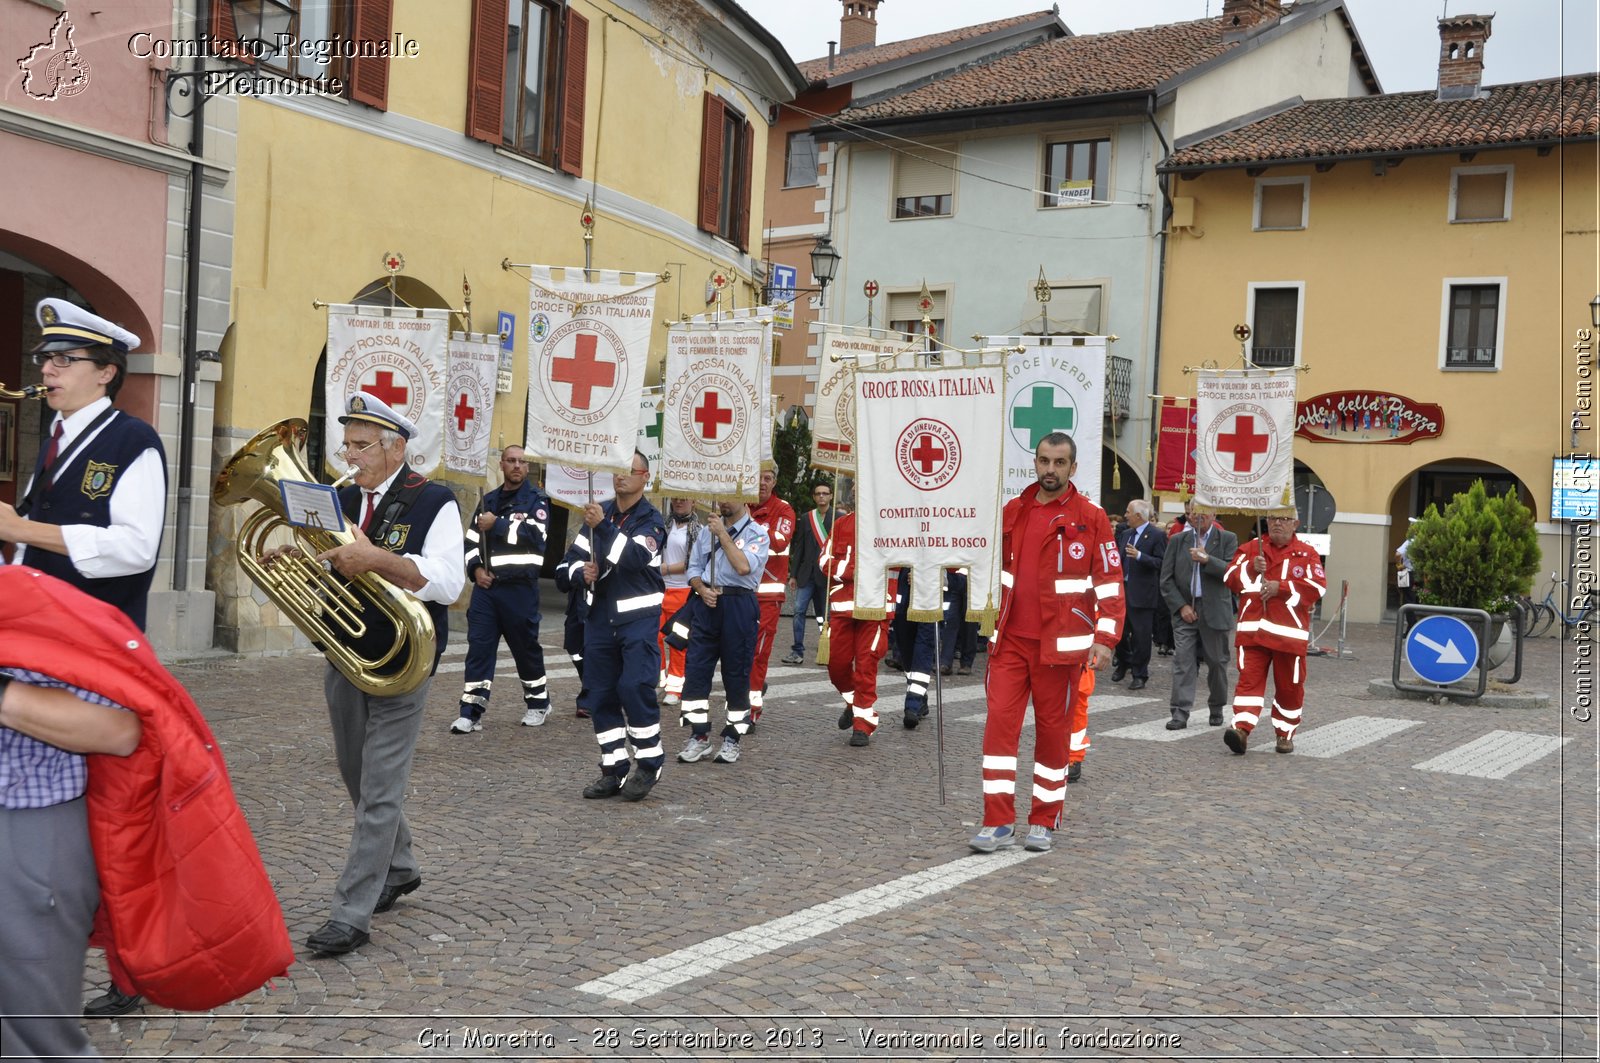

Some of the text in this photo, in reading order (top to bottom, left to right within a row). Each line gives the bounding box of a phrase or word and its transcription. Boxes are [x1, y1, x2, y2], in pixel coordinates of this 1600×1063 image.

[1060, 189, 1089, 197] VENDESI
[611, 296, 648, 307] SOCCORSO
[530, 301, 564, 313] CROCE
[606, 306, 651, 318] ITALIANA
[399, 322, 432, 332] SOCCORSO
[543, 321, 590, 357] CONVENZIONE
[593, 322, 603, 331] DI
[605, 328, 626, 363] GINEVRA
[720, 336, 731, 345] DEL
[832, 340, 849, 349] CORPO
[851, 342, 880, 352] VOLONTARI
[330, 344, 356, 383] CROCE
[356, 335, 400, 351] ROSSA
[403, 339, 441, 391] ITALIANA
[1006, 356, 1092, 391] ROCE VERDE
[357, 354, 424, 420] DI GINEVRA 22 AGOSTO
[667, 358, 760, 410] CROCE ROSSA ITALIANA
[691, 383, 700, 393] DI
[700, 376, 734, 393] GINEVRA
[862, 376, 995, 398] CROCE ROSSA ITALIANA
[1251, 382, 1262, 390] DEL
[732, 392, 741, 403] 22
[1198, 390, 1294, 400] CROCE ROSSA ITALIANA
[1208, 404, 1247, 434] CONVENZIONE
[1250, 405, 1258, 413] DI
[1338, 395, 1380, 411] della
[1386, 396, 1437, 433] Piazza
[732, 406, 745, 439] AGOSTO
[914, 423, 942, 435] GINEVRA
[542, 425, 579, 439] COMITATO
[586, 433, 619, 444] LOCALE
[908, 430, 915, 439] DI
[942, 431, 950, 441] 22
[547, 437, 608, 457] MORETTA
[900, 437, 921, 484] CONVENZIONE
[947, 441, 957, 471] AGOSTO
[668, 459, 753, 473] COMITATO LOCALE DI
[663, 470, 695, 481] BORGO
[706, 473, 756, 485] DALMAZO
[1009, 468, 1036, 479] PINE
[1201, 483, 1238, 494] COMITATO
[1241, 486, 1270, 494] LOCALE
[1273, 485, 1282, 493] DI
[1211, 495, 1270, 506] RACCONIGI
[879, 506, 976, 519] COMITATO LOCALE
[921, 521, 930, 532] DI
[873, 537, 987, 548] SOMMARIVA DEL BOSCO
